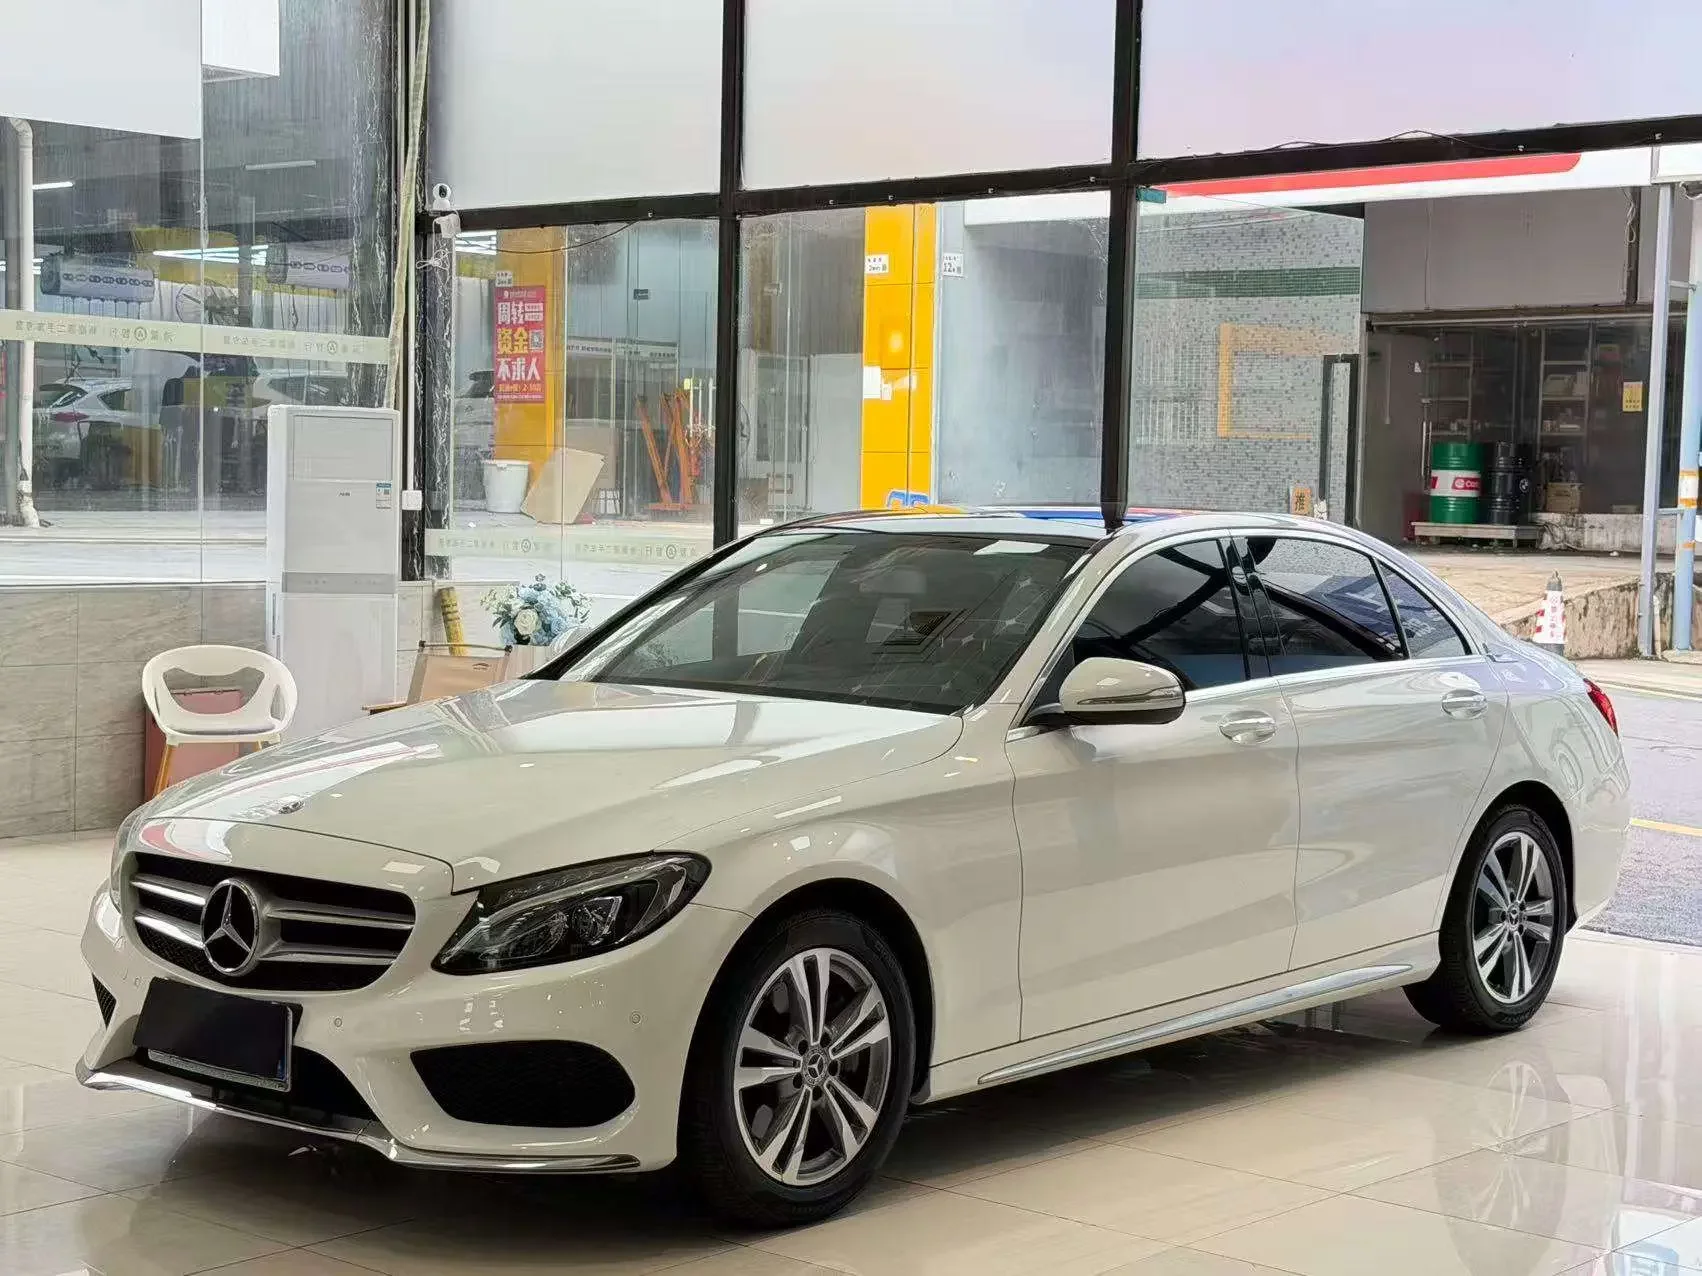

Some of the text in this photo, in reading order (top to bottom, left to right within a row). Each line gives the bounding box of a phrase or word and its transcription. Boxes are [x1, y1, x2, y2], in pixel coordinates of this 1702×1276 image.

[498, 301, 525, 324] 周转
[497, 327, 528, 354] 资金
[497, 356, 541, 380] 不求人
